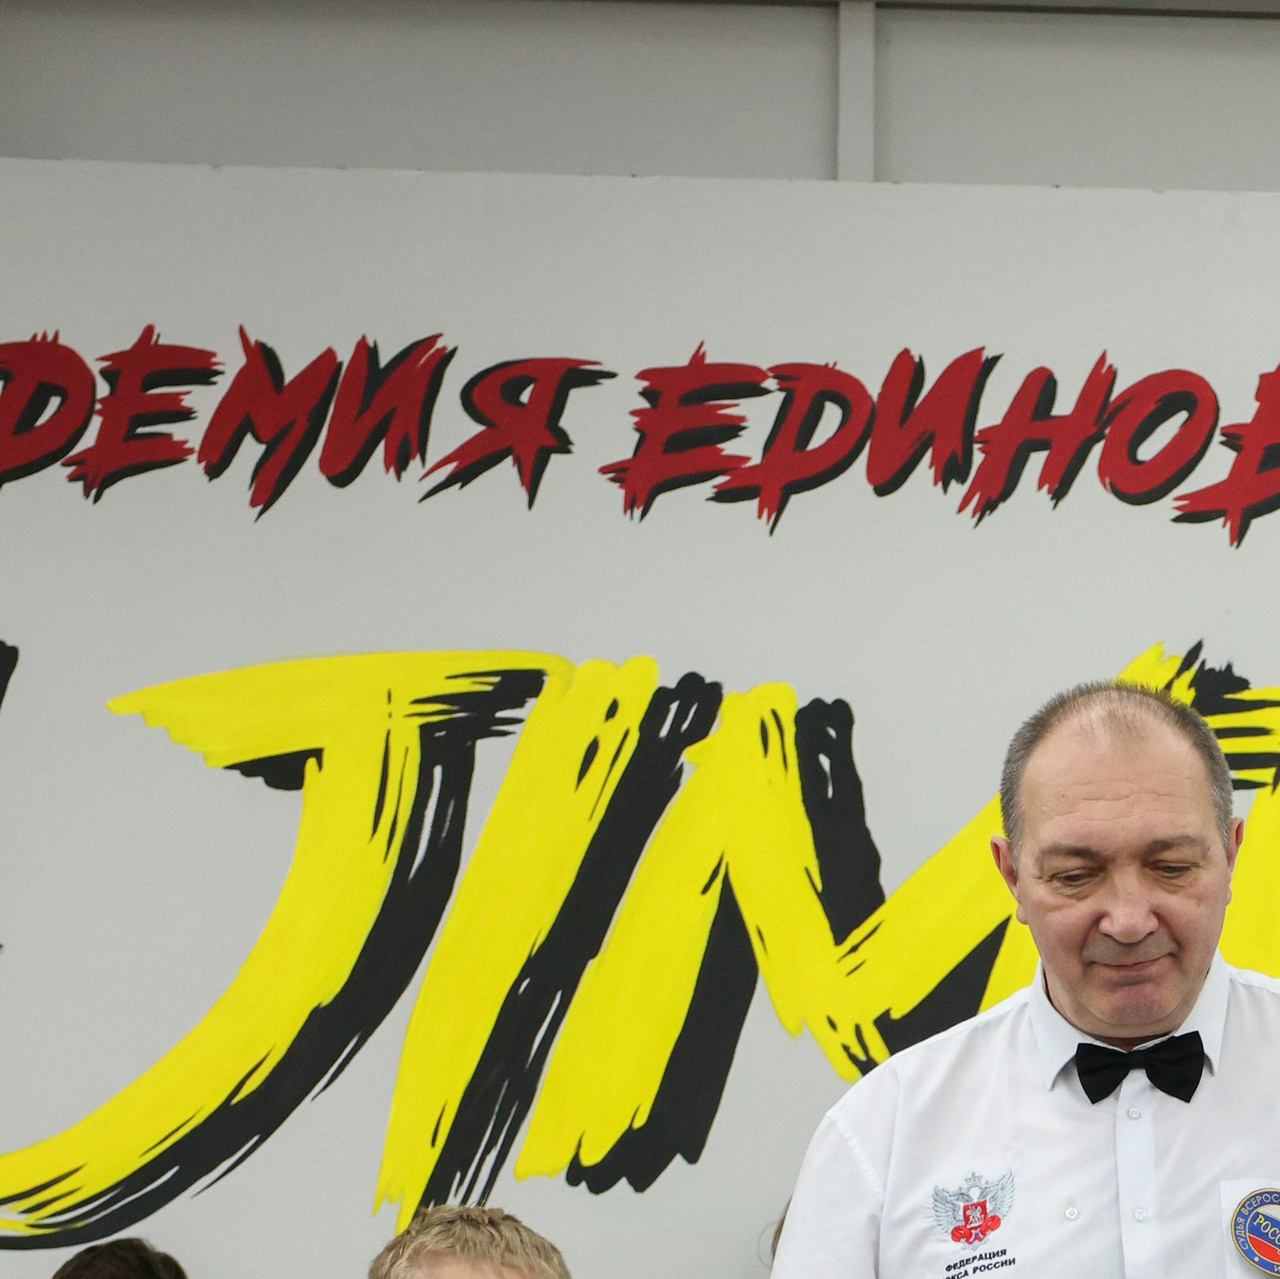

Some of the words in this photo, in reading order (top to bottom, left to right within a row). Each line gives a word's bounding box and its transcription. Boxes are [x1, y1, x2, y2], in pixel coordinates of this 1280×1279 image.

[1235, 1217, 1249, 1250] СУДЬЯ
[945, 1248, 1007, 1273] ФЕДЕРАЦИЯ
[972, 1258, 1016, 1275] РОССИИ
